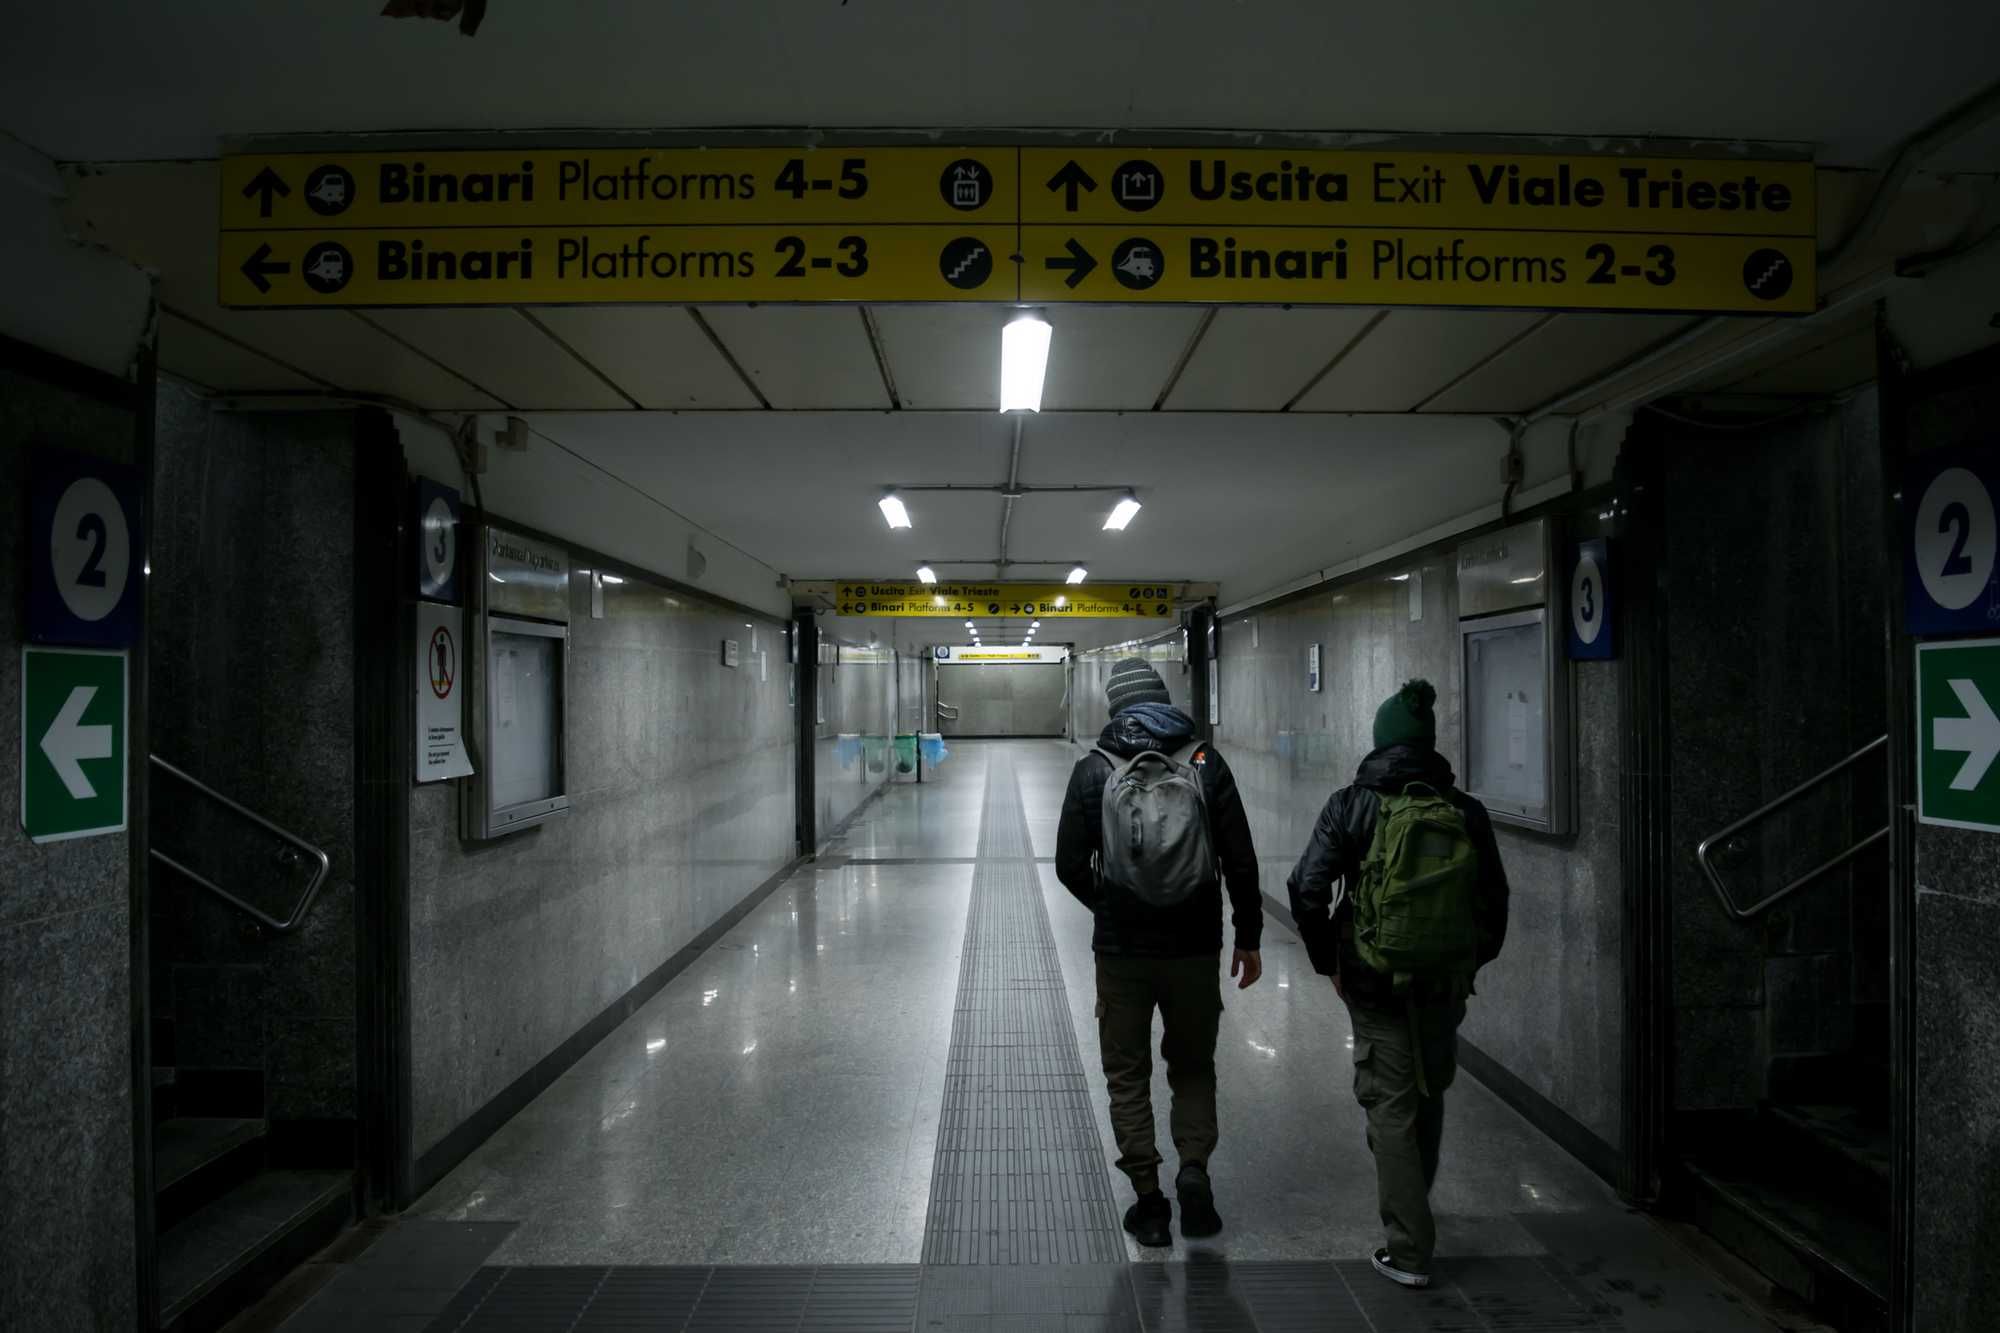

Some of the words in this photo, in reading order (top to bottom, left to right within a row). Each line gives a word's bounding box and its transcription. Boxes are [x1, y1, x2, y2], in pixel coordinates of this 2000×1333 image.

[378, 162, 534, 203] Binari
[558, 159, 756, 201] Platforms
[774, 158, 869, 199] 4-5
[1188, 160, 1348, 203] Uscita
[1373, 162, 1446, 204] Exit
[1467, 163, 1605, 208] Viale
[1619, 167, 1792, 213] Trieste
[377, 239, 533, 281] Binari
[557, 236, 755, 279] Platforms
[775, 235, 869, 278] 2-3
[1189, 237, 1348, 281] Binari
[1372, 238, 1566, 285] Platforms
[1585, 243, 1676, 286] 2-3
[76, 512, 107, 588] 2
[1938, 502, 1973, 577] 2
[871, 602, 904, 612] Binari
[929, 586, 959, 596] Viale
[961, 587, 1000, 597] Trieste
[1039, 603, 1072, 612] Binari
[1077, 603, 1119, 613] Platforms
[1581, 577, 1594, 622] 3
